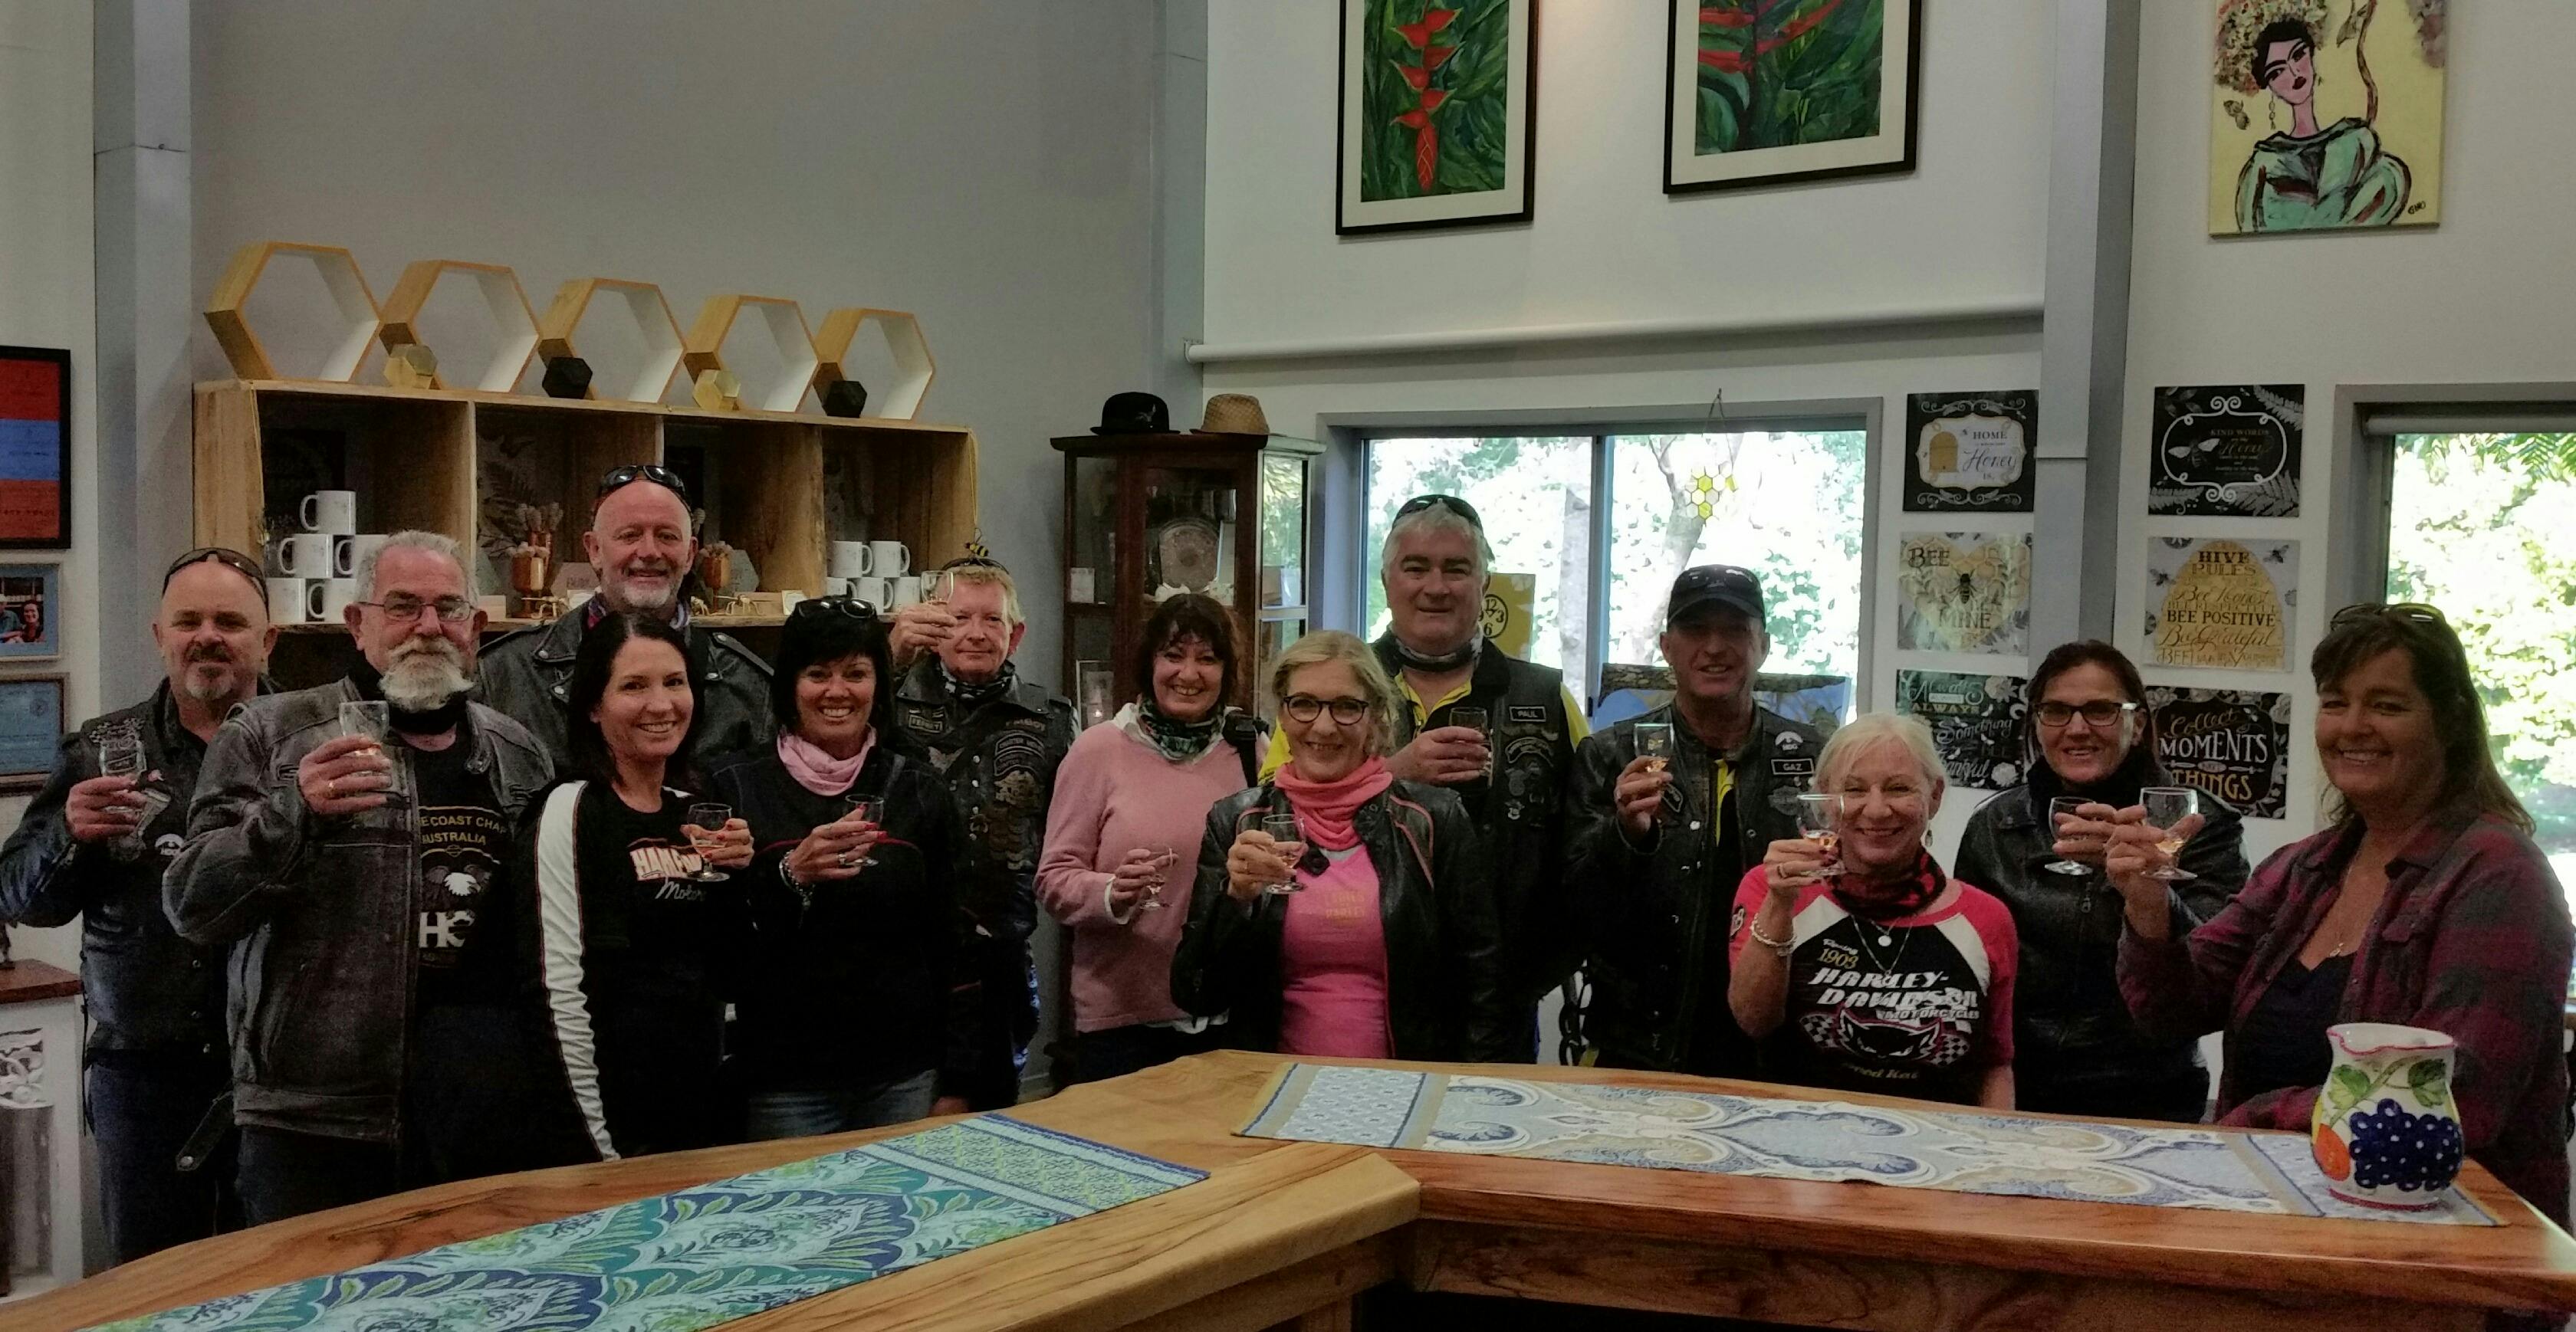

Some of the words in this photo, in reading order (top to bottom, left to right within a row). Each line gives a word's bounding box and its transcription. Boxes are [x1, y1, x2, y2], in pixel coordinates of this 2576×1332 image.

[1973, 431, 2007, 440] HOME
[1963, 448, 2018, 472] Honey
[1907, 546, 1950, 569] BEE
[2197, 550, 2251, 563] HIVE
[1484, 599, 1498, 612] 12
[1939, 608, 1992, 629] MINE
[2167, 610, 2197, 623] BEE
[2202, 611, 2276, 626] POSITIVE
[1912, 703, 1980, 714] ALWAYS
[1937, 718, 2013, 743] Something
[2159, 729, 2269, 763] MOMENTS
[2171, 769, 2252, 800] THINGS
[422, 832, 486, 845] AUSTRALIA
[1817, 948, 1859, 969] 1903
